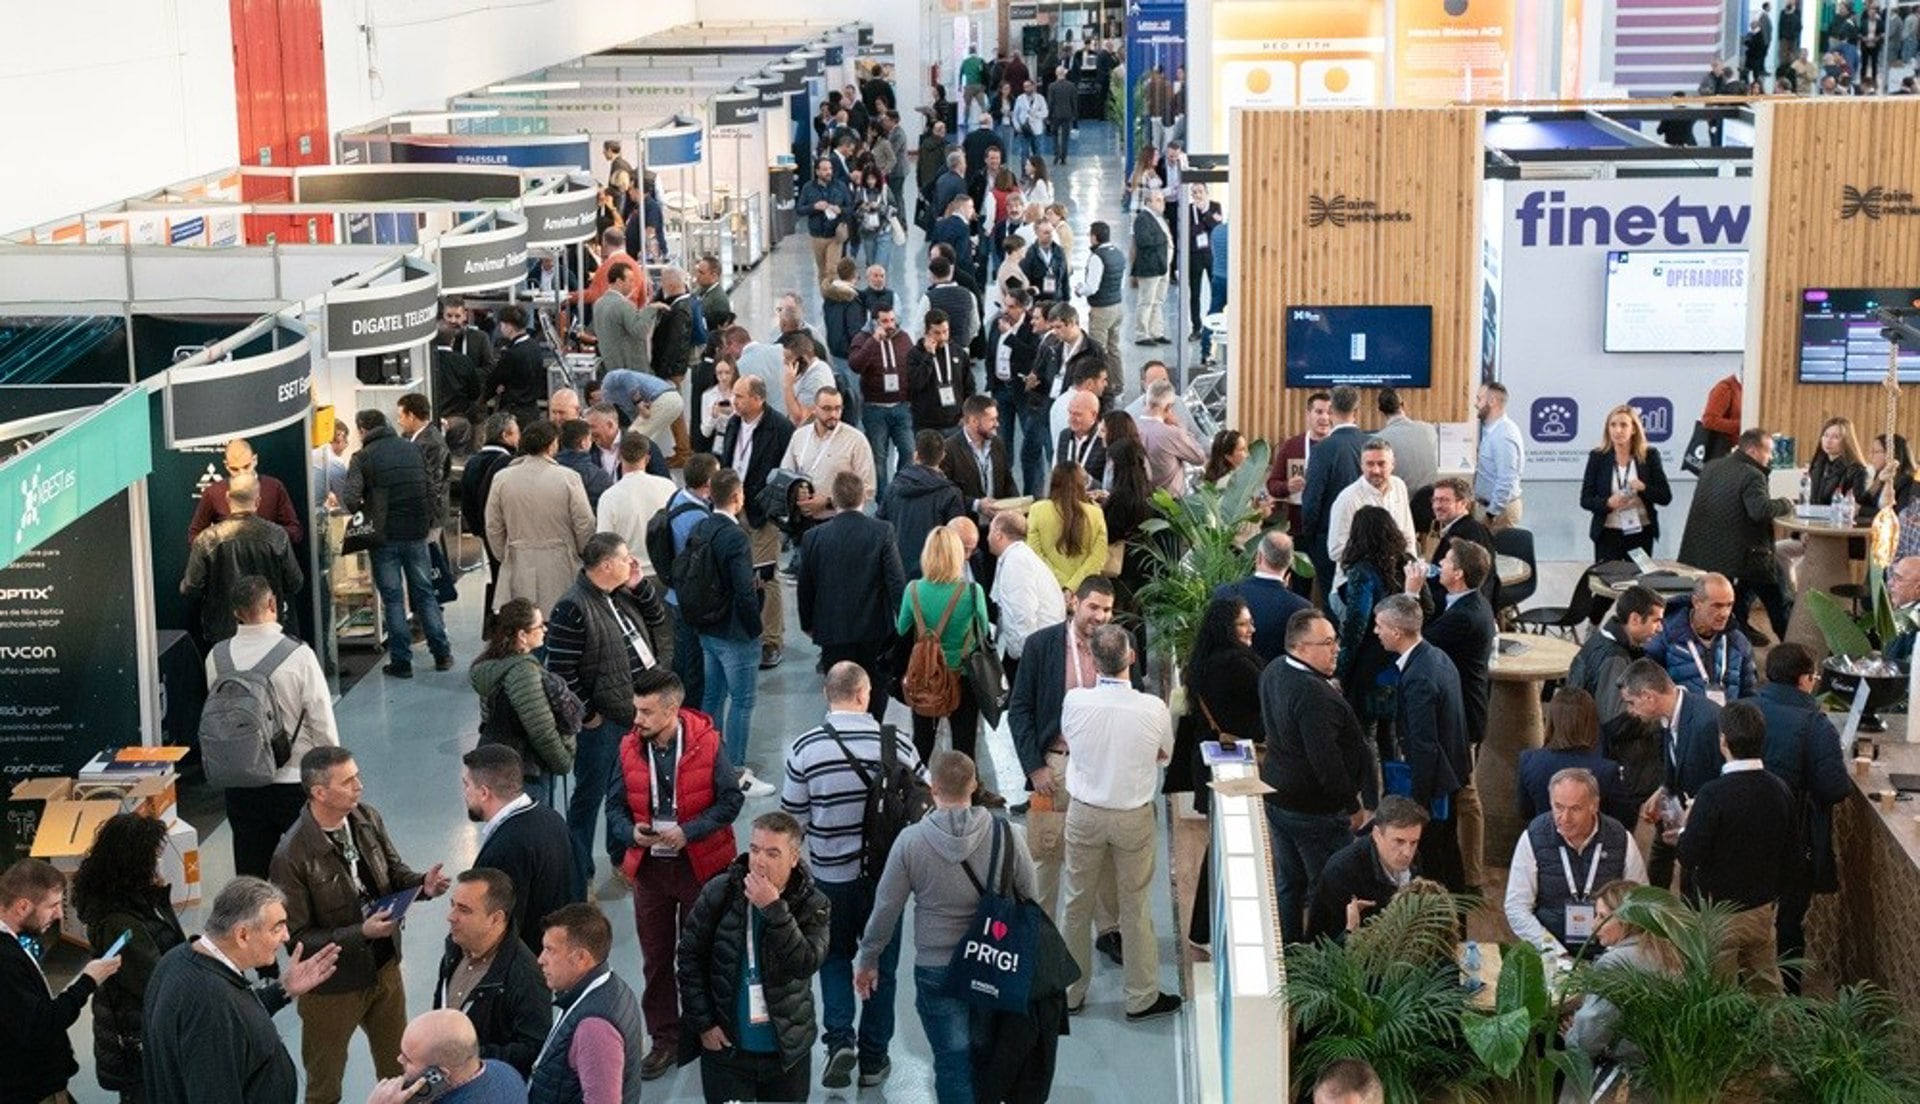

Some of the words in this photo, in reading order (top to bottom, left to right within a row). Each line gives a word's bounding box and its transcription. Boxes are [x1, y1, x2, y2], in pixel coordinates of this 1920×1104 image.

[1346, 210, 1412, 222] networks
[1516, 190, 1751, 246] finetw
[1666, 268, 1744, 288] OPERADORES
[352, 315, 404, 336] DIGATEL
[278, 379, 299, 403] ESET
[983, 917, 992, 936] I
[963, 940, 1019, 973] PRTG!
